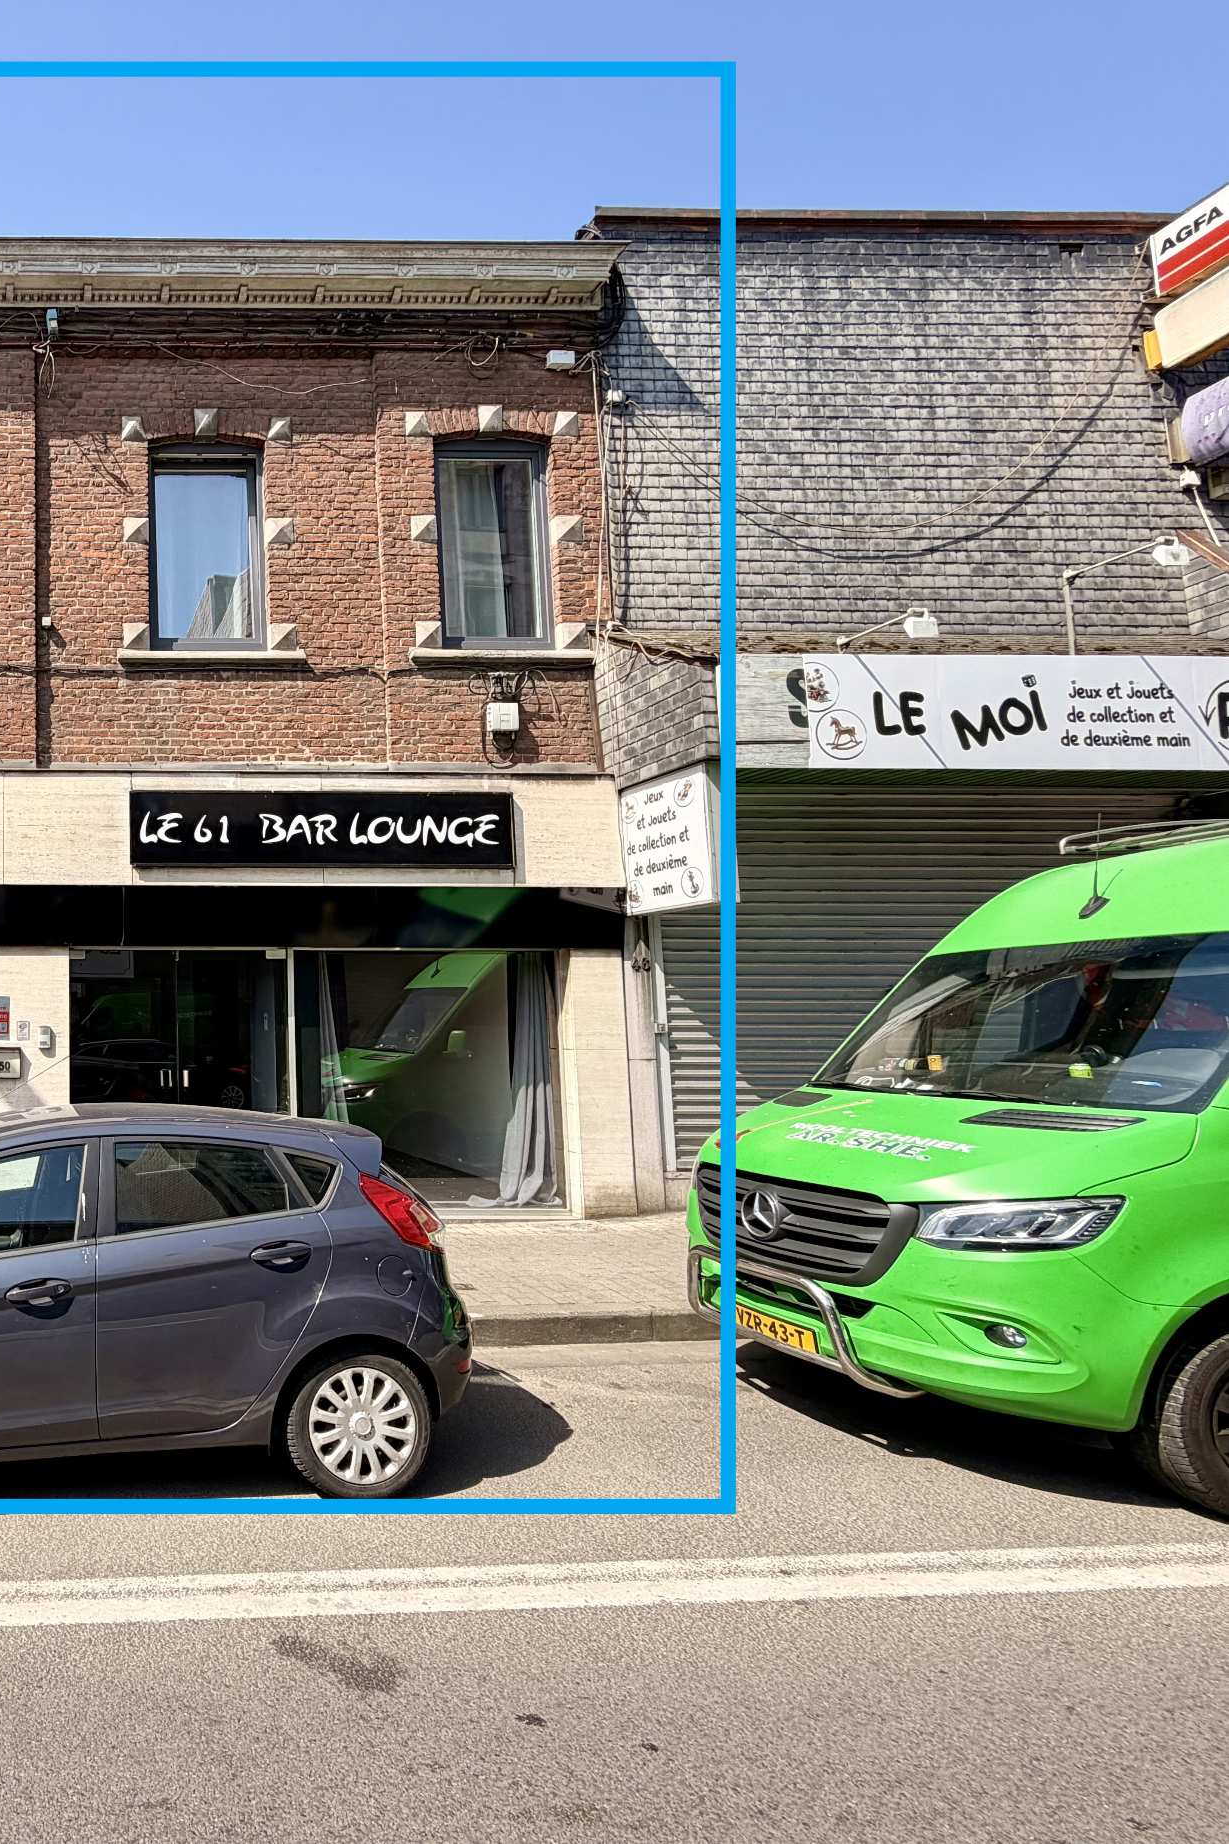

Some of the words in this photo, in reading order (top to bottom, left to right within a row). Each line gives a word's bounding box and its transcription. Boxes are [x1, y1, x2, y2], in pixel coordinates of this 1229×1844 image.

[1160, 206, 1224, 256] AGFA
[1069, 680, 1102, 699] jeux
[1106, 682, 1123, 699] et
[1126, 680, 1175, 700] jouets
[872, 690, 927, 737] LE
[1066, 705, 1086, 722] de
[1089, 706, 1156, 723] collection
[1159, 706, 1176, 723] et
[1060, 729, 1080, 746] de
[1083, 729, 1153, 746] deuxième
[1157, 733, 1191, 747] main
[139, 811, 184, 844] LE
[193, 815, 230, 844] 61
[259, 813, 339, 845] BAR
[349, 811, 500, 848] LOUNGE
[636, 814, 646, 830] et
[626, 841, 637, 856] de
[638, 832, 677, 853] collection
[679, 826, 690, 842] et
[633, 862, 645, 877] de
[645, 853, 688, 875] deuxième
[652, 882, 674, 897] main
[736, 1306, 804, 1349] VZR-43-T
